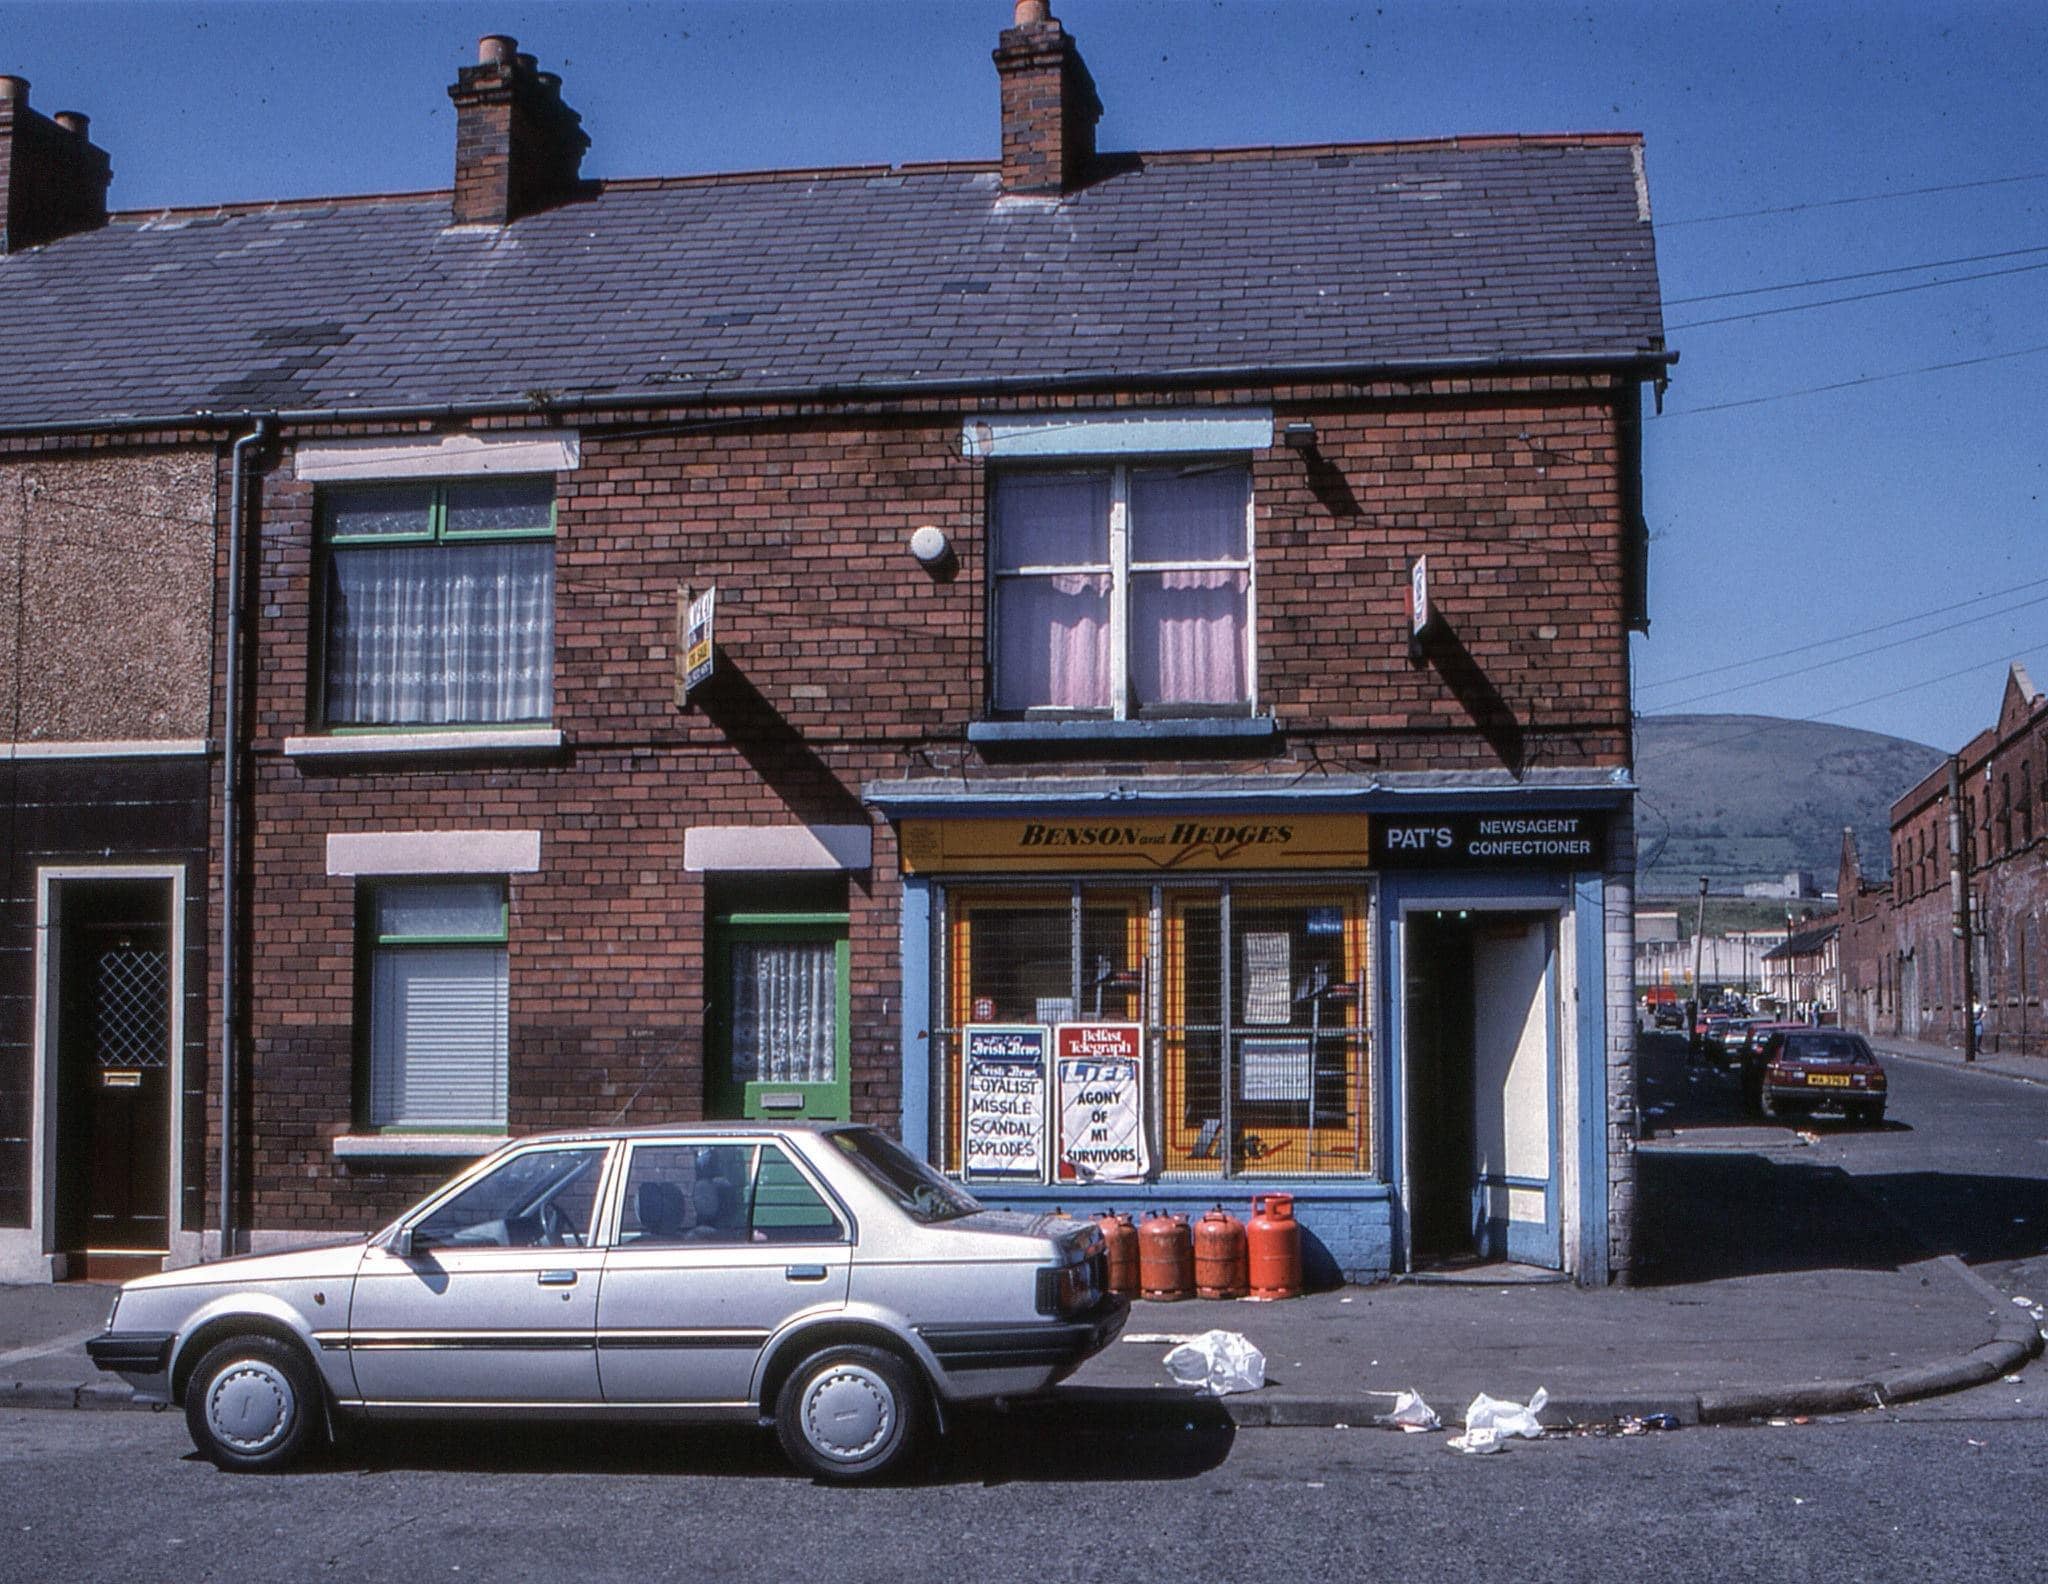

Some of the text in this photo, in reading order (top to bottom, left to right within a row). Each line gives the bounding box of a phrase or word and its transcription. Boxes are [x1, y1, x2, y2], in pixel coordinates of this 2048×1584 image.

[1019, 823, 1293, 846] BENSON and HEDGES
[1480, 819, 1579, 834] NEWSAGENT
[1387, 828, 1453, 849] PAT'S
[1469, 840, 1590, 855] CONFECTIONER
[1082, 1029, 1121, 1042] Belfast
[971, 1042, 1041, 1056] Irish News
[1068, 1040, 1131, 1057] Telegraph
[971, 1076, 1039, 1095] LOYALIST
[1077, 1091, 1121, 1105] AGONY
[972, 1098, 1032, 1115] MISSILE
[1091, 1111, 1107, 1124] OF
[970, 1118, 1035, 1137] SCANDAL
[969, 1139, 1035, 1157] EXPLODES
[1067, 1149, 1136, 1163] SURVIVORS
